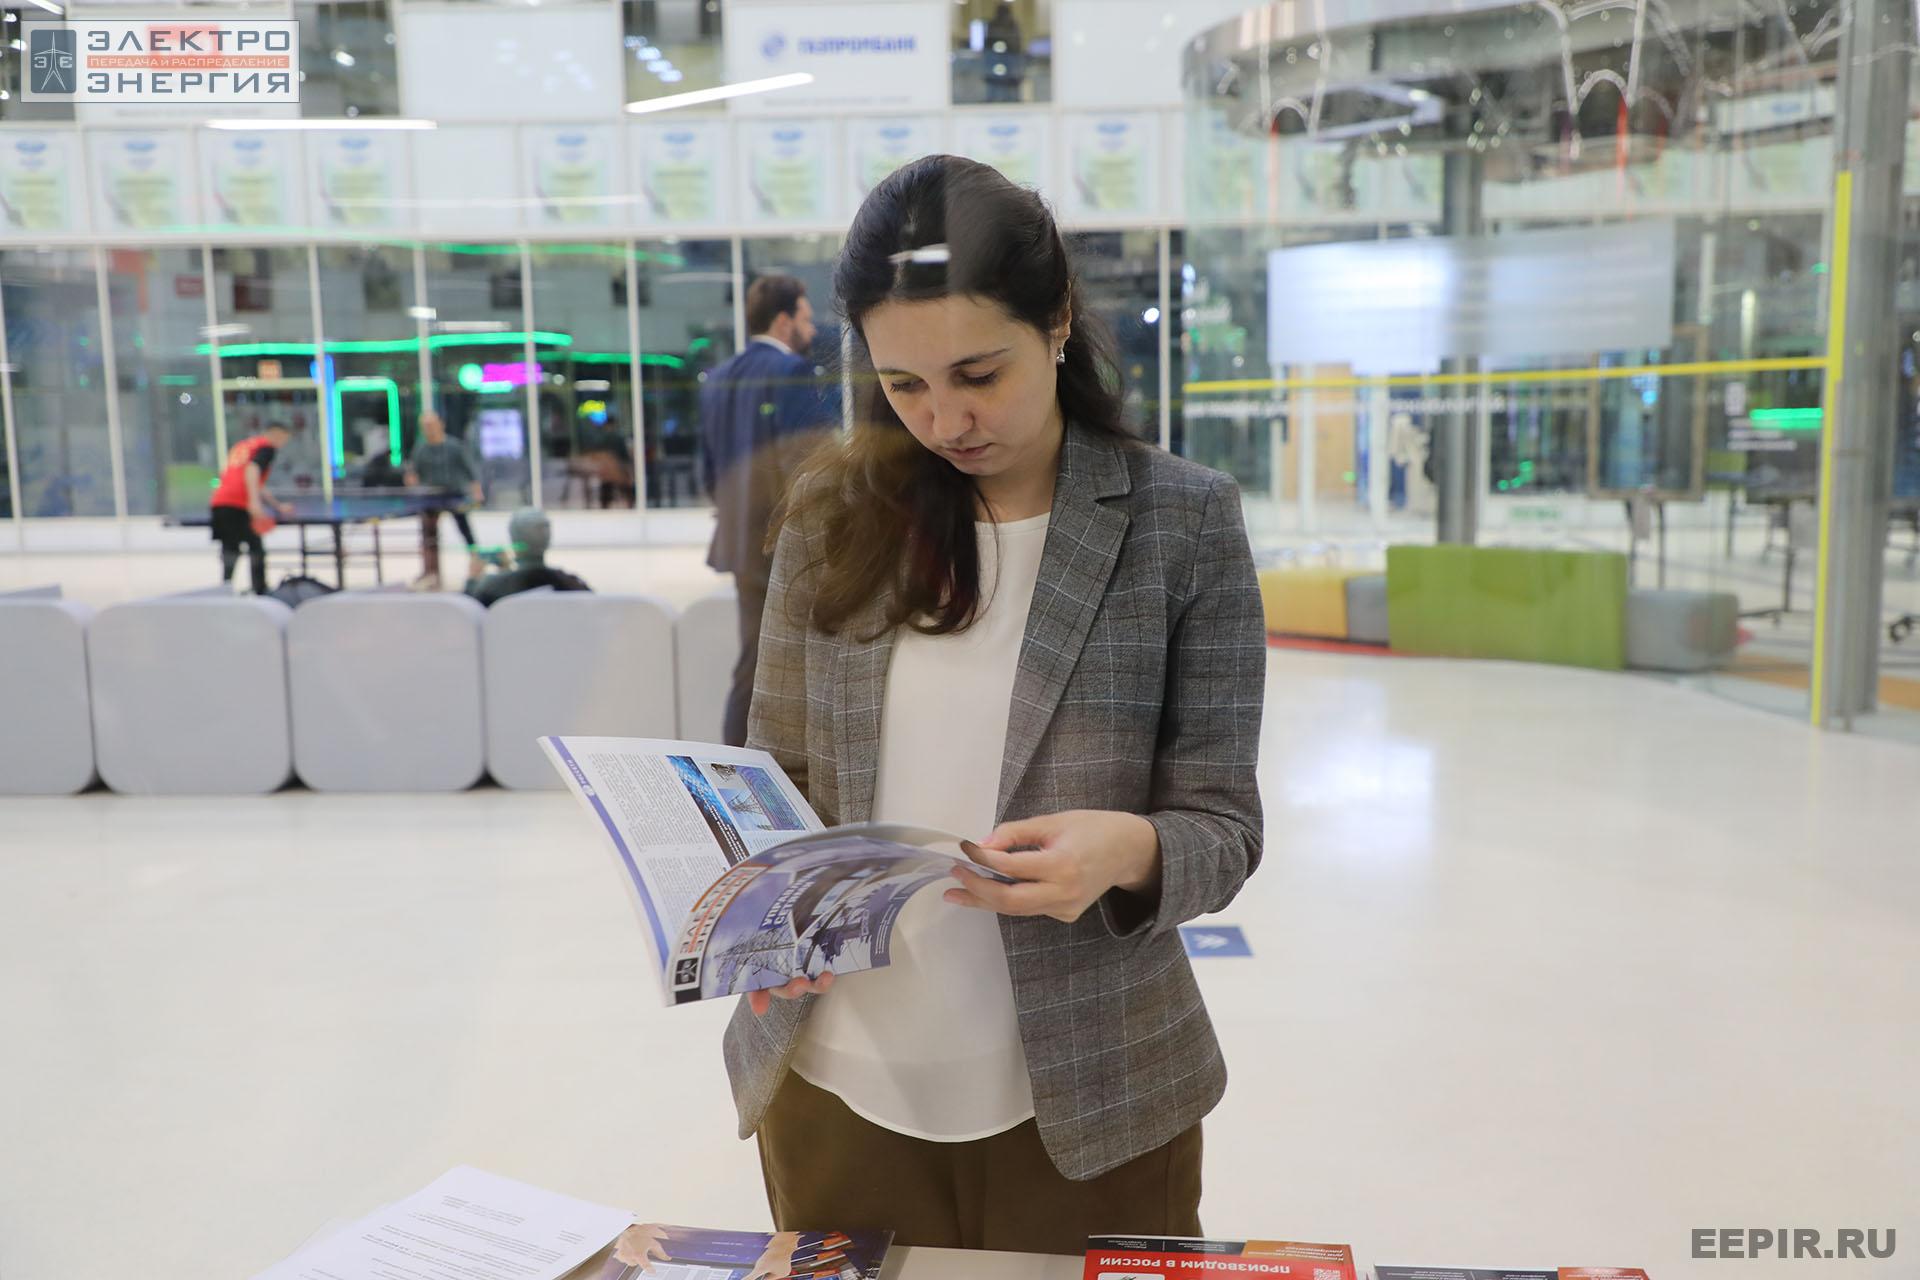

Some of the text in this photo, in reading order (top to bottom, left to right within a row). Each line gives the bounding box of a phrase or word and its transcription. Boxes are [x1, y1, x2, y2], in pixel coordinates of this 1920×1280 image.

[1100, 1257, 1290, 1274] ПРОИЗВОДИМ В РОССИИ
